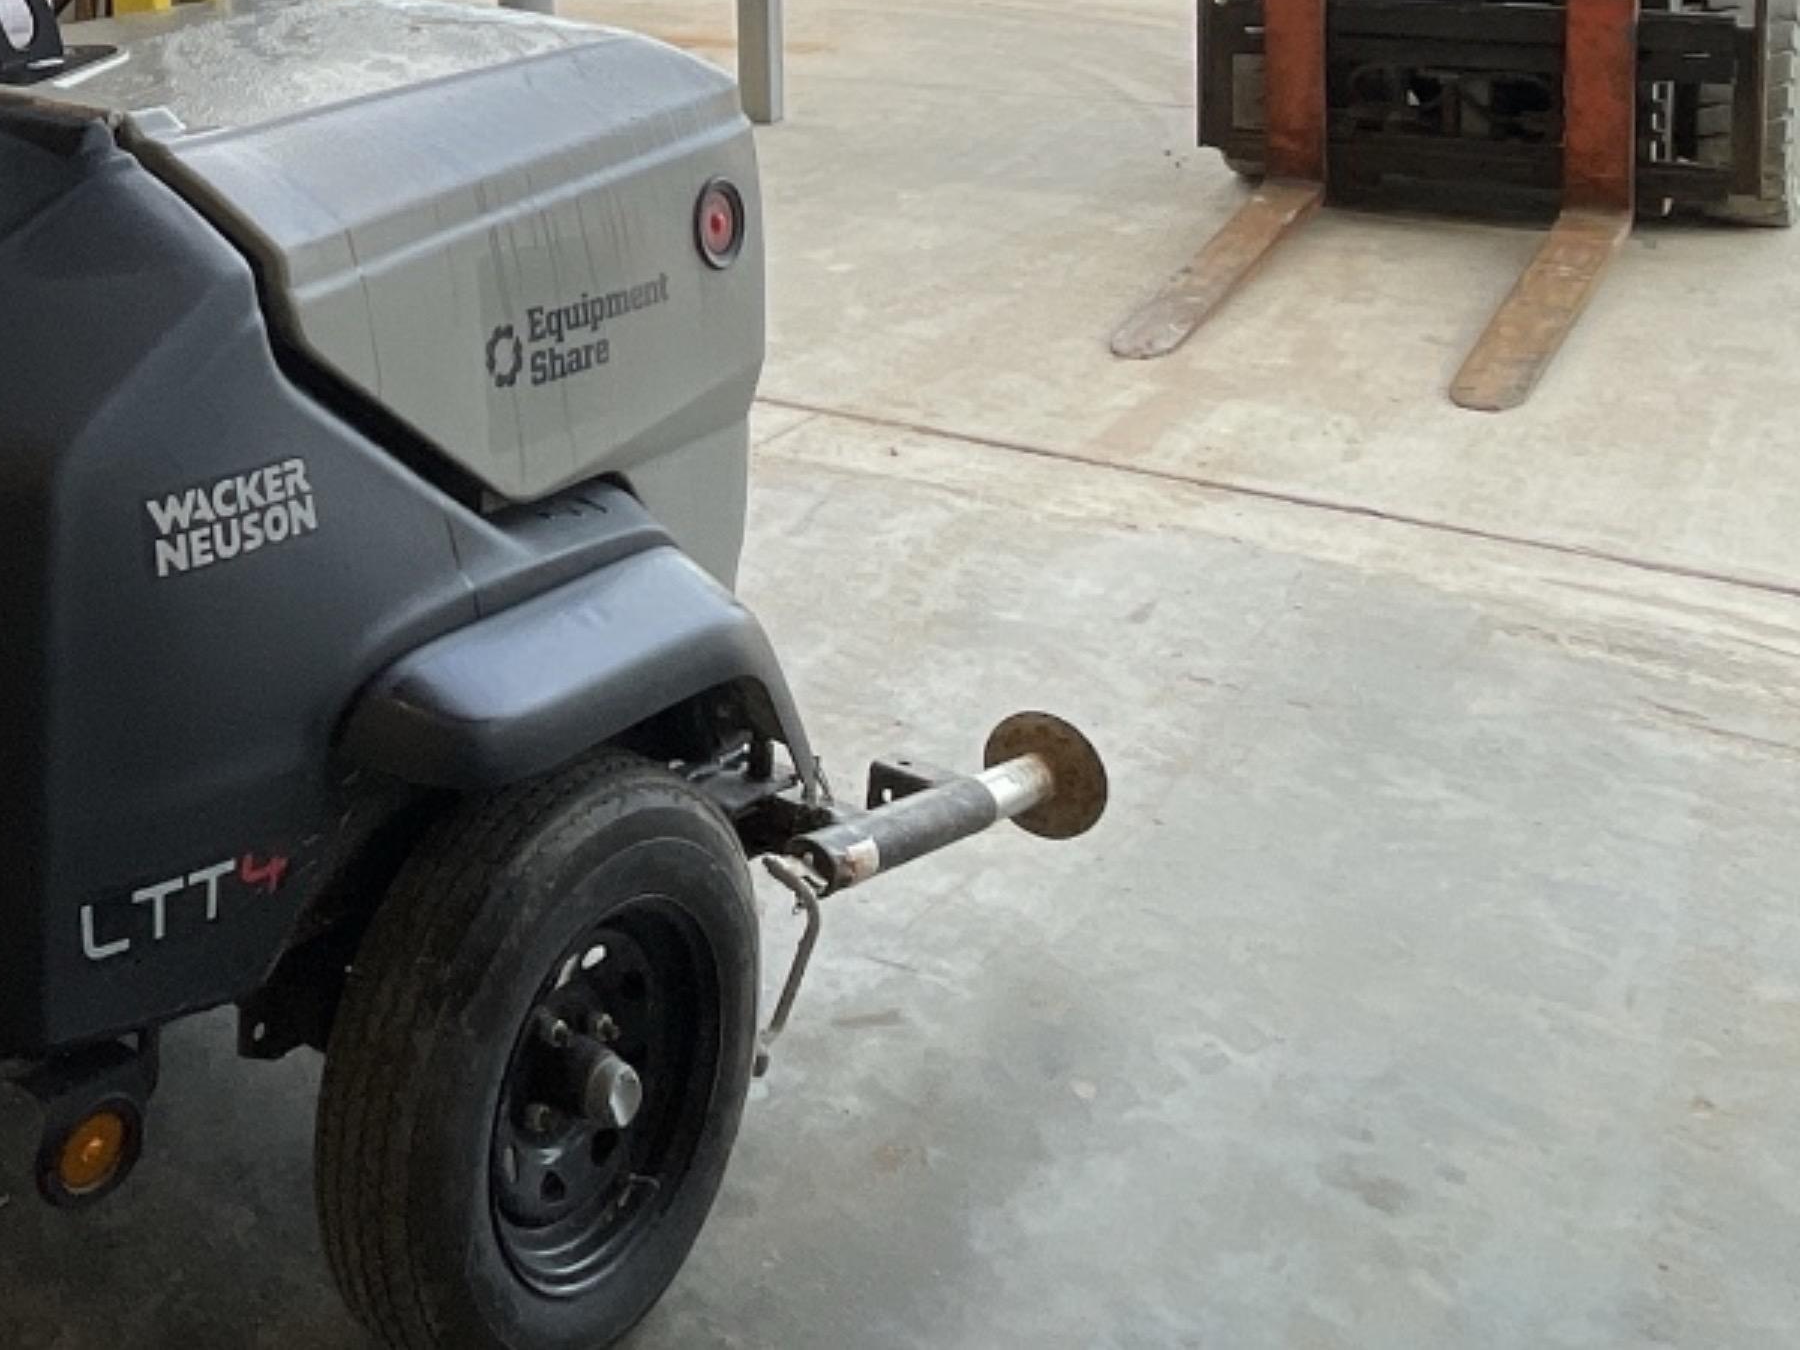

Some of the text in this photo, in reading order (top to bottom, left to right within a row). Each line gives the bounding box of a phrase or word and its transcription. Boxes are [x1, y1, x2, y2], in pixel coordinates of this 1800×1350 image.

[526, 271, 669, 343] Equipment
[530, 338, 610, 387] Share
[146, 457, 313, 536] WACKER
[154, 493, 319, 577] NEUSON
